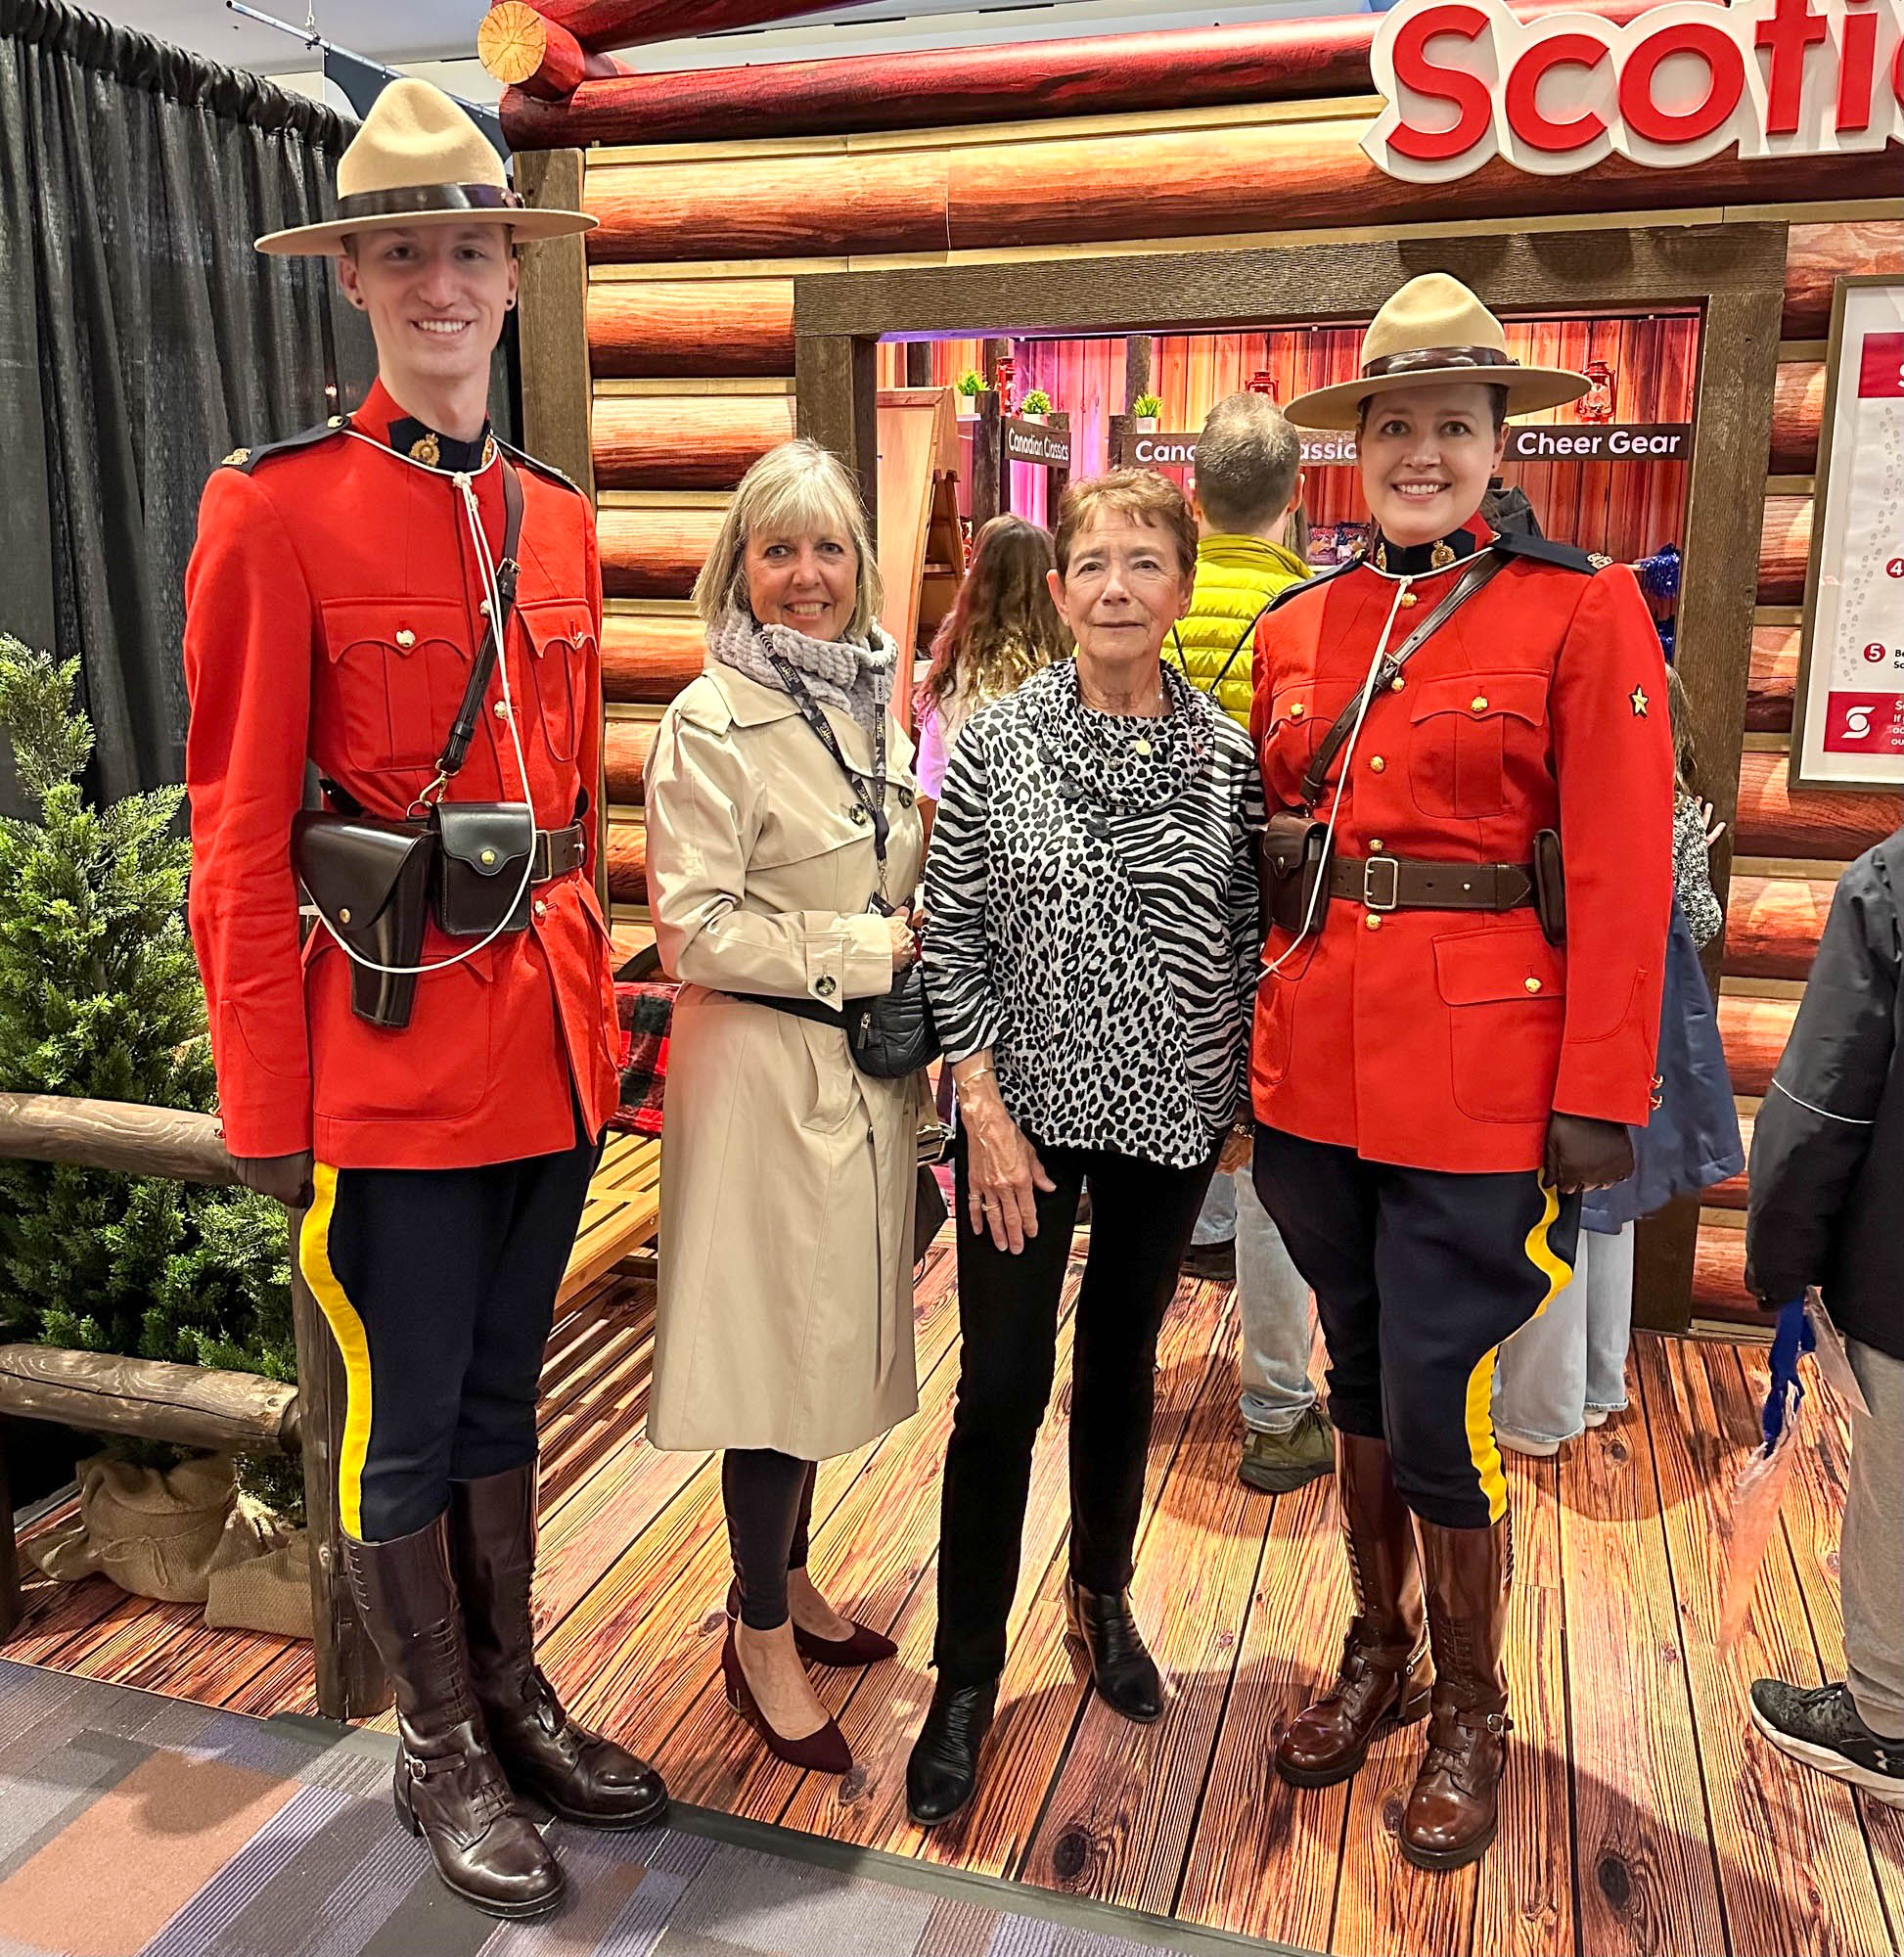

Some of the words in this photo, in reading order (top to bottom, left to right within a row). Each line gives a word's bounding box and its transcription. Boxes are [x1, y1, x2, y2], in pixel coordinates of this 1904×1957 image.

[1385, 0, 1904, 161] Scoti
[1008, 427, 1044, 457] Canadian
[1044, 435, 1069, 462] Classics
[1517, 432, 1604, 455] Cheer
[1609, 431, 1681, 454] Gear
[1889, 561, 1903, 576] 4
[1868, 645, 1881, 660] 5
